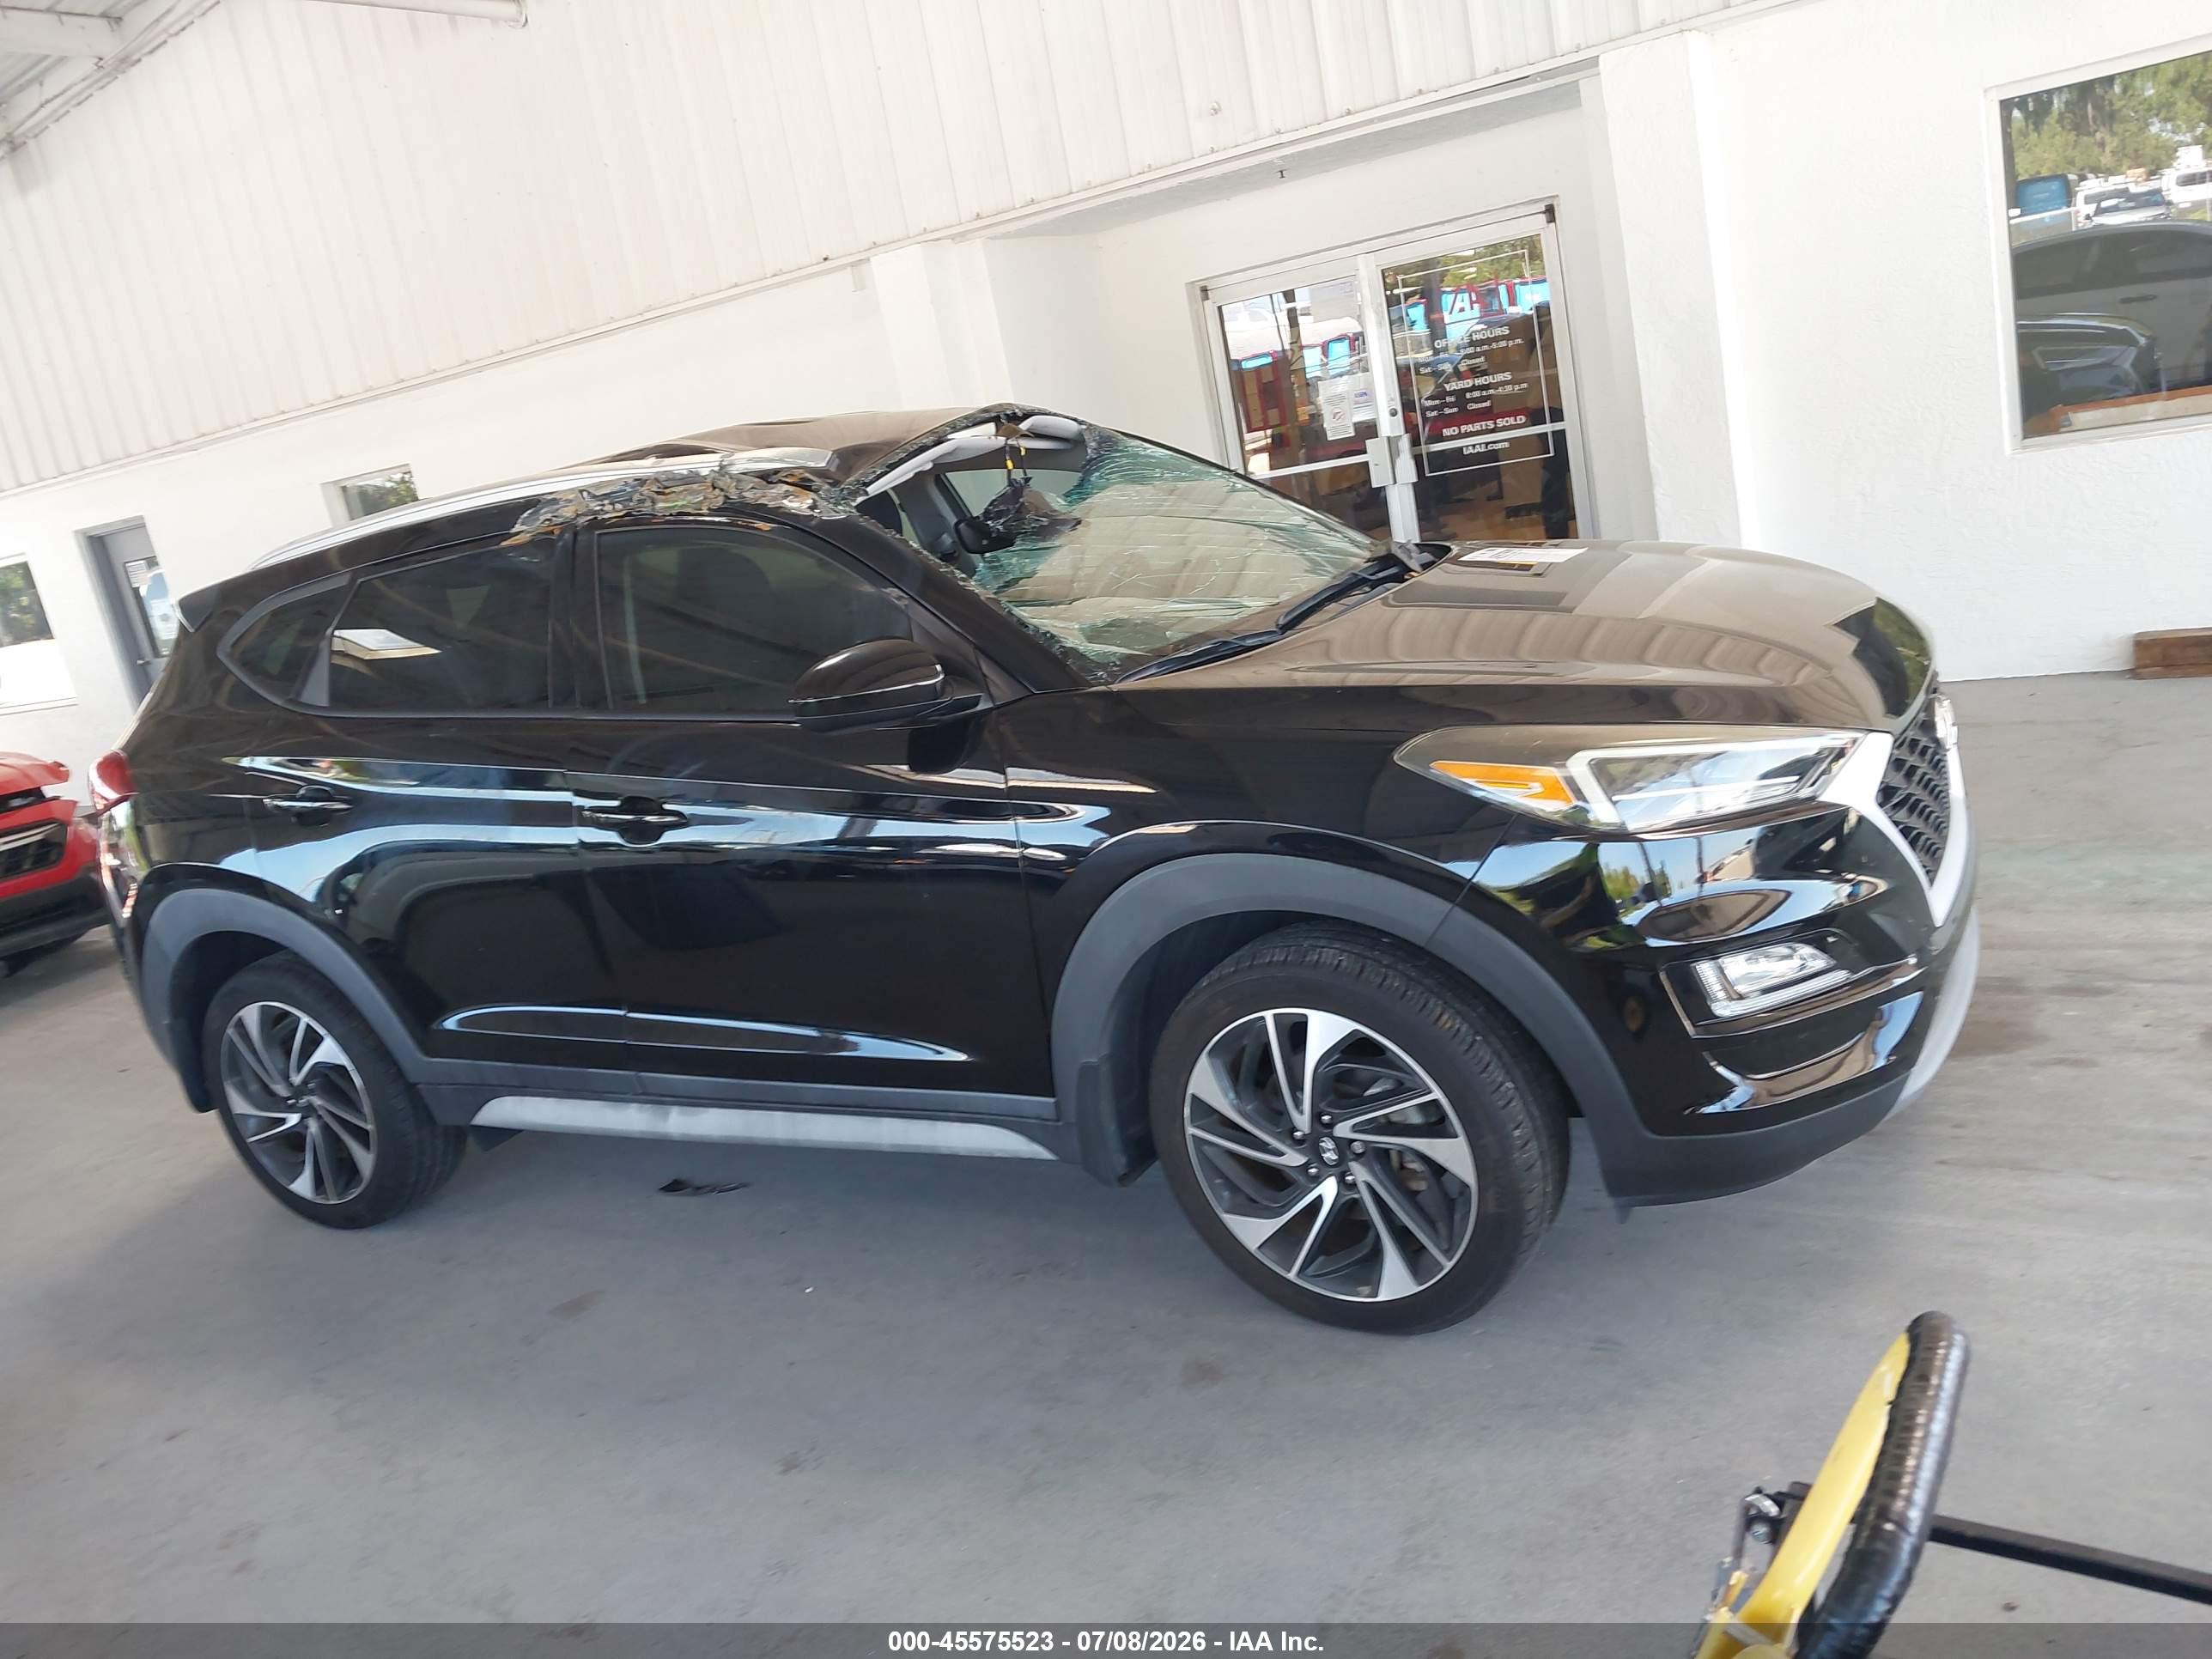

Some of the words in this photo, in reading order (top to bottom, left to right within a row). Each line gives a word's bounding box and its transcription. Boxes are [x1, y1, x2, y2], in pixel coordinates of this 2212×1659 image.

[1434, 336, 1471, 349] OFFICE
[1472, 325, 1510, 341] HOURS
[1461, 356, 1486, 365] Closed
[1443, 379, 1474, 392] YARD
[1474, 372, 1512, 386] HOURS
[1467, 400, 1492, 410] Closed
[1442, 427, 1459, 436] NO
[1461, 420, 1495, 433] PARTS
[1496, 415, 1526, 426] SOLD
[1462, 441, 1510, 455] IAAI.com
